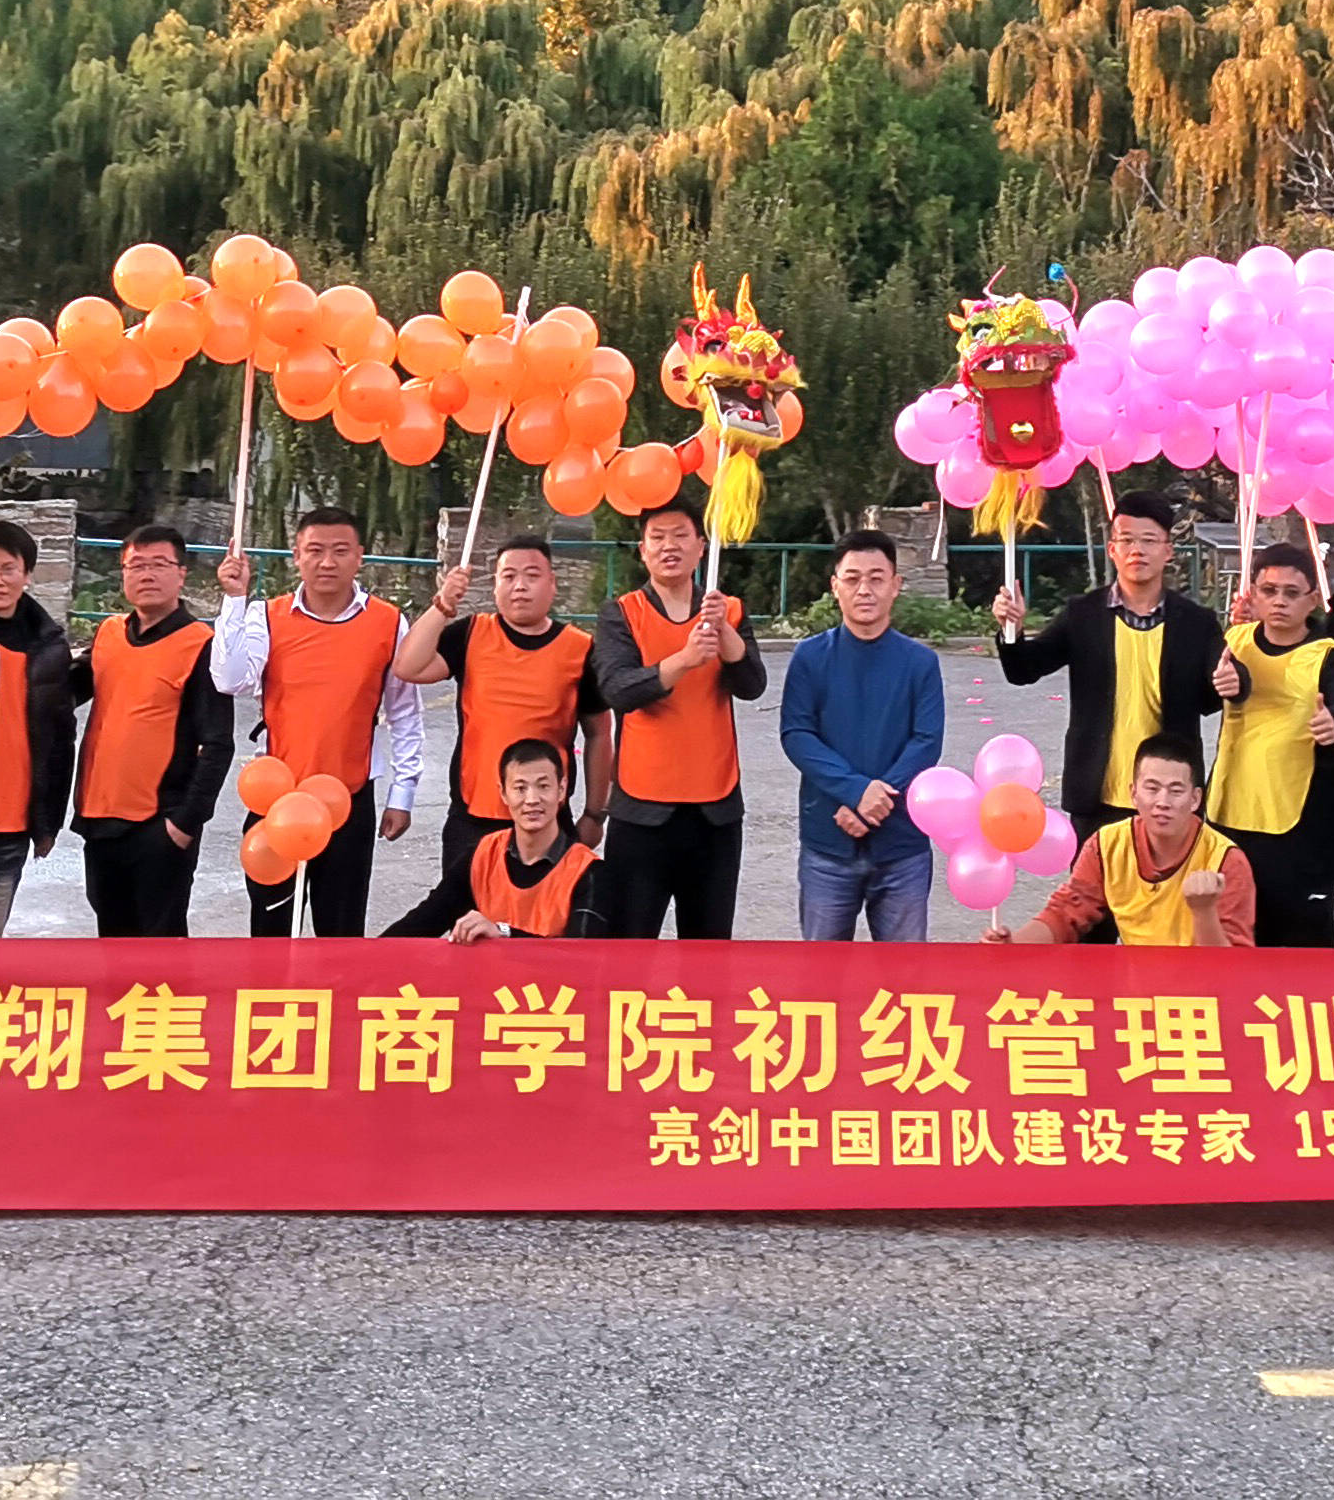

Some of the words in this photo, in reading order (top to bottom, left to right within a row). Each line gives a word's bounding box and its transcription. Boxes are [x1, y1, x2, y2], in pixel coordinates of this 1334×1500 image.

[650, 1108, 1254, 1166] 亮剑中国团队建设专家
